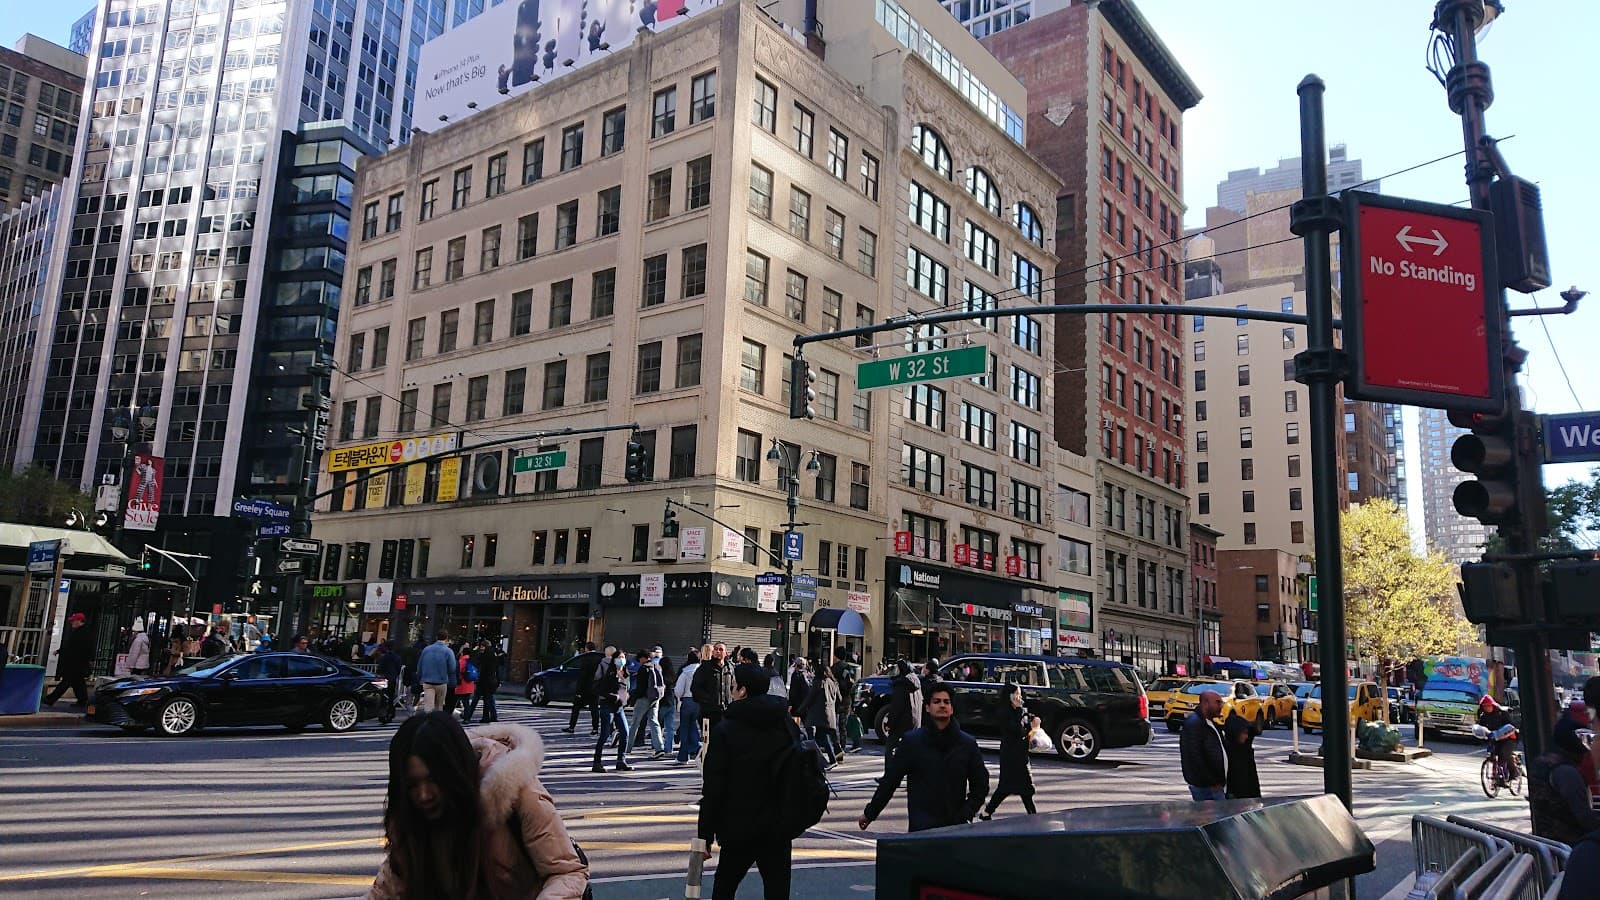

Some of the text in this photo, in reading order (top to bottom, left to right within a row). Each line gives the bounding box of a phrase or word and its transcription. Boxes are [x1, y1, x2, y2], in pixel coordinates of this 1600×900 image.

[425, 65, 486, 99] Now that's Big
[1370, 256, 1475, 291] No Standing
[889, 356, 950, 380] W 32 St
[527, 455, 552, 469] W 32 St
[128, 499, 160, 512] Give
[234, 502, 263, 516] Greeley
[264, 506, 290, 518] Square
[125, 509, 157, 525] Style
[285, 525, 290, 534] St
[681, 579, 709, 589] DIALS
[913, 570, 940, 585] National
[491, 586, 511, 600] The
[818, 598, 831, 607] 894
